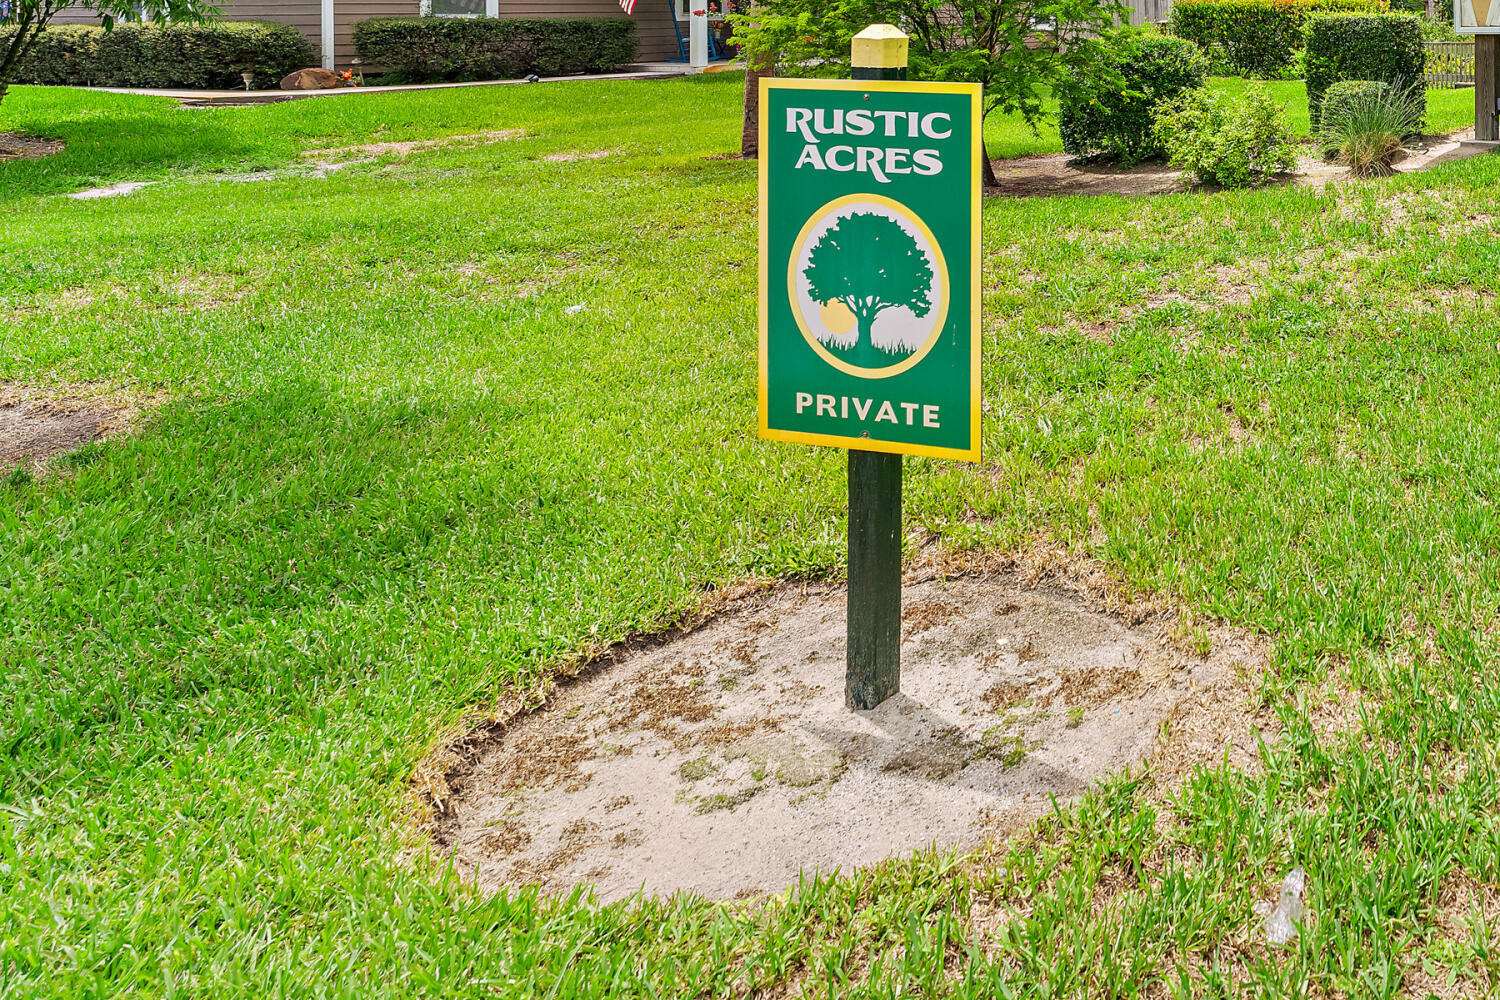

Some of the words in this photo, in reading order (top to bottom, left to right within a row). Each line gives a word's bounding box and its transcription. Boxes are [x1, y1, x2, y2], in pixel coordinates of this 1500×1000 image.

[785, 107, 952, 142] RUSTIC
[795, 144, 943, 183] ACRES
[796, 392, 940, 428] PRIVATE
